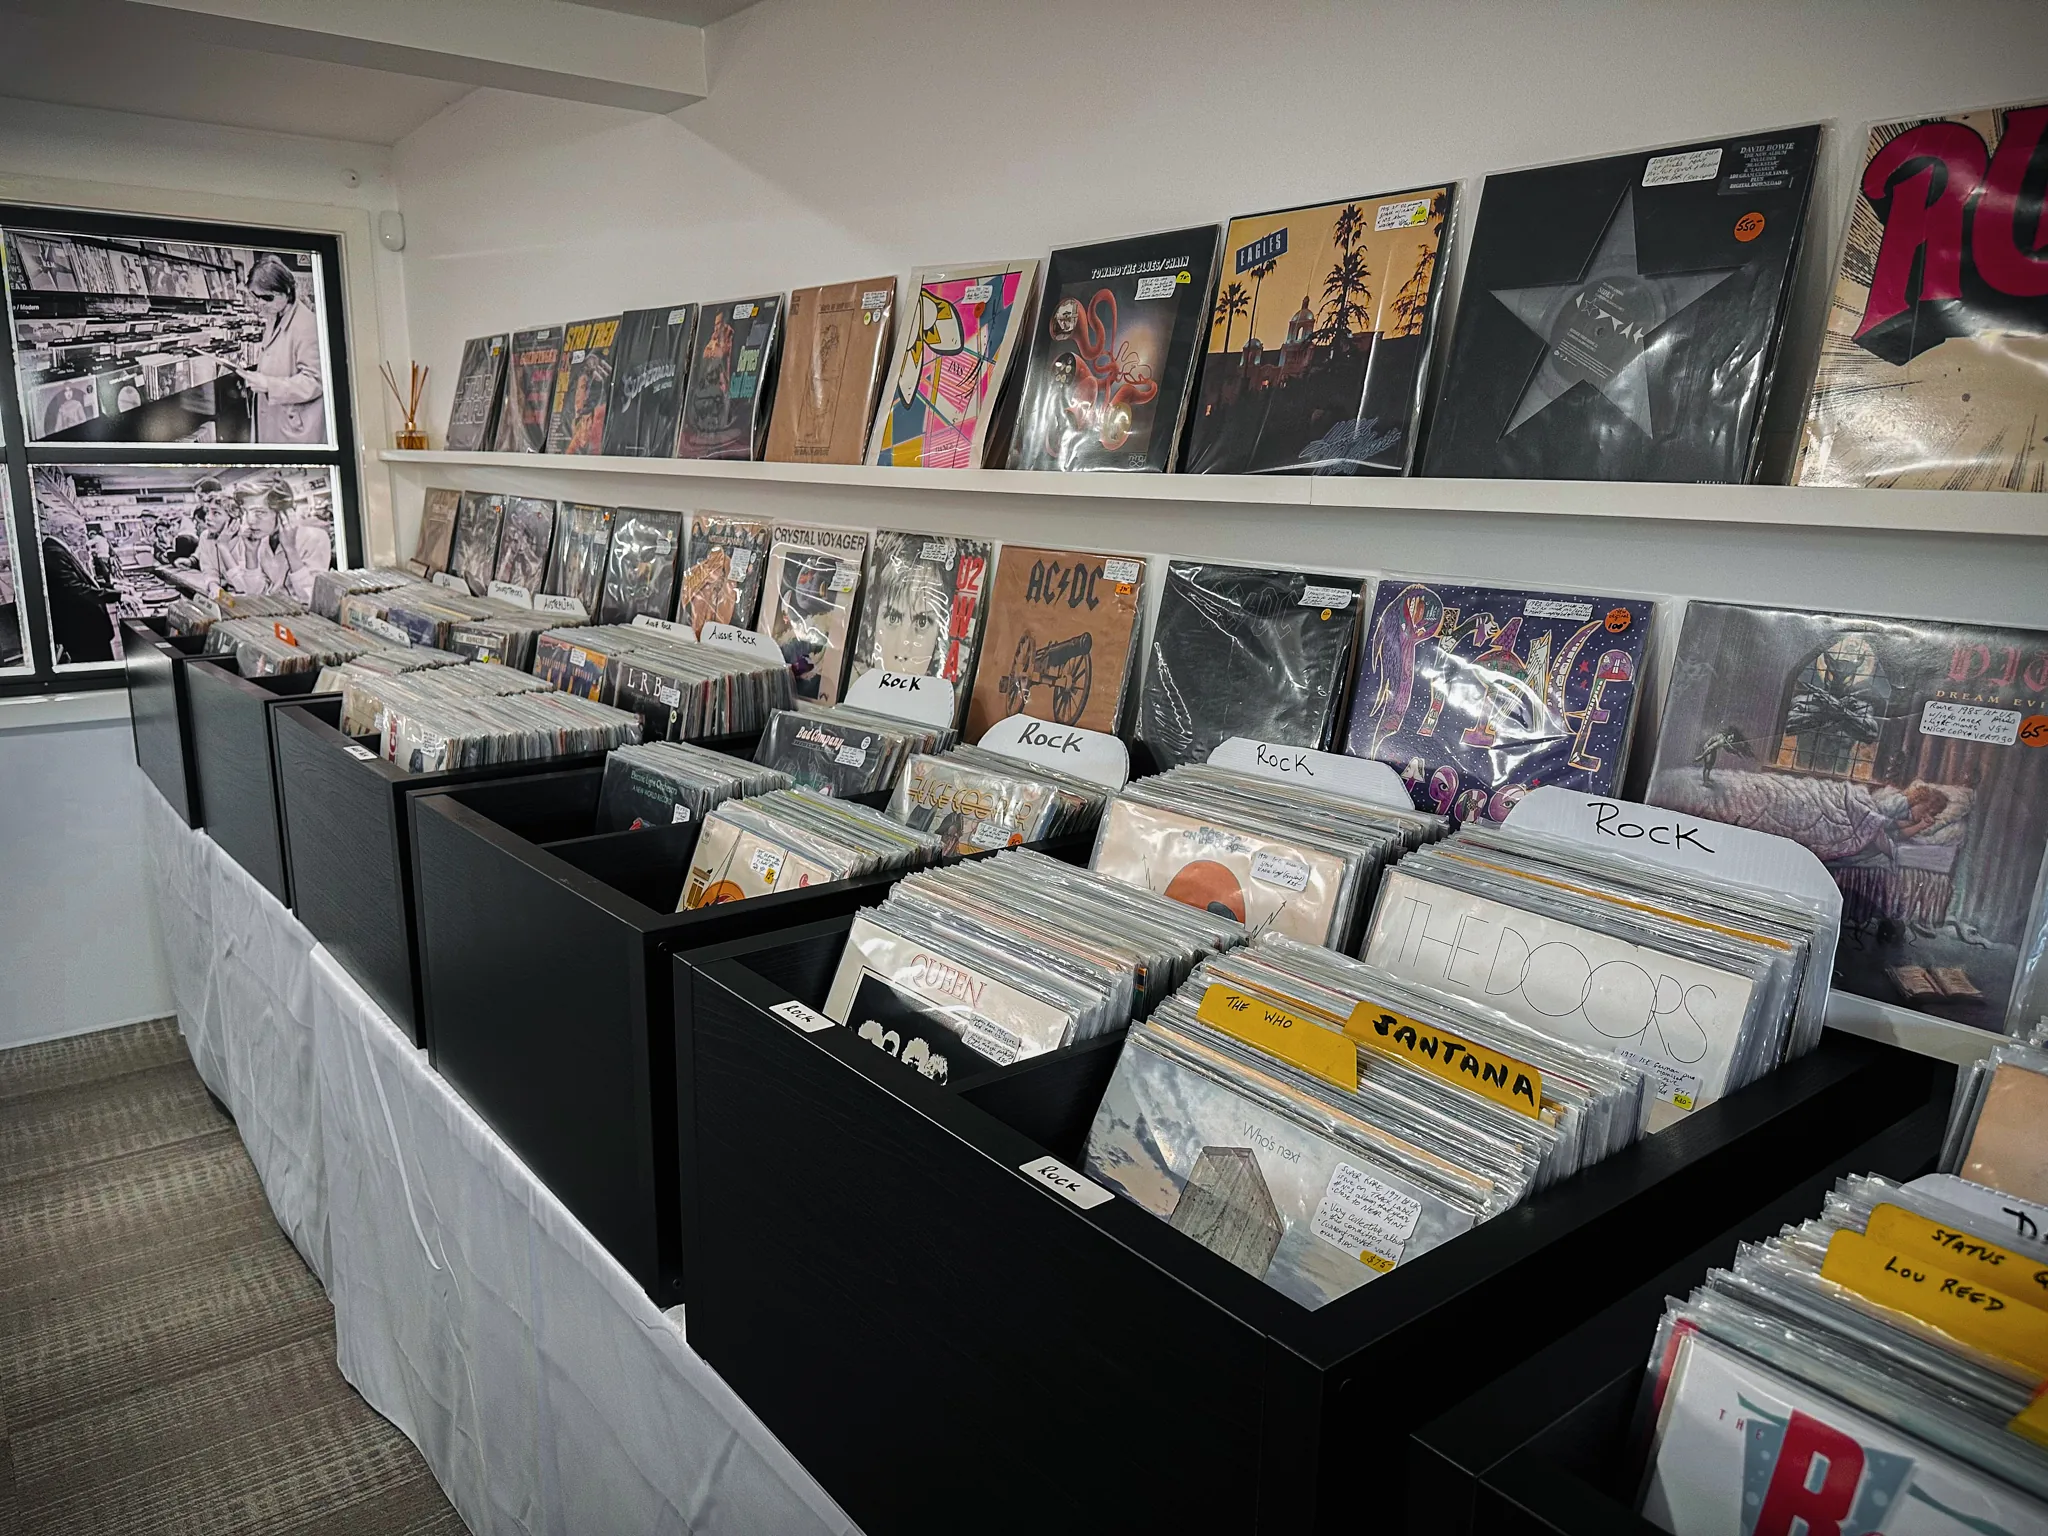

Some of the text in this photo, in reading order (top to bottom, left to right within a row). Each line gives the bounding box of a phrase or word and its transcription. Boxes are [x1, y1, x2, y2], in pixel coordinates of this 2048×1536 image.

[1740, 141, 1795, 154] DAVID BOWIE
[1240, 233, 1281, 266] EAGLES
[1091, 265, 1122, 279] TOWARD
[1121, 263, 1137, 275] THE
[563, 319, 621, 352] STAR TREK
[774, 527, 866, 552] CRYSTAL VOYAGER
[956, 554, 985, 591] U2
[1935, 690, 2045, 709] DREAM EVI
[795, 726, 814, 741] Bad
[810, 729, 845, 751] Company
[909, 953, 988, 1009] QUEEN
[1398, 895, 1718, 1065] THE DOORS
[1225, 996, 1293, 1030] THE WHO
[1371, 1013, 1536, 1108] SANTANA
[1242, 1121, 1302, 1165] Who's next
[1355, 1193, 1377, 1207] album
[1356, 1185, 1367, 1193] on
[1384, 1189, 1401, 1202] 1971
[1320, 1209, 1328, 1217] in
[1343, 1222, 1382, 1245] condition
[1330, 1203, 1346, 1219] Very
[1383, 1214, 1408, 1230] MINT
[1374, 1246, 1398, 1262] value
[1931, 1228, 2007, 1267] STATUS
[1884, 1256, 1927, 1284] LOU
[1940, 1277, 2006, 1313] REED
[1718, 1407, 1763, 1441] THE
